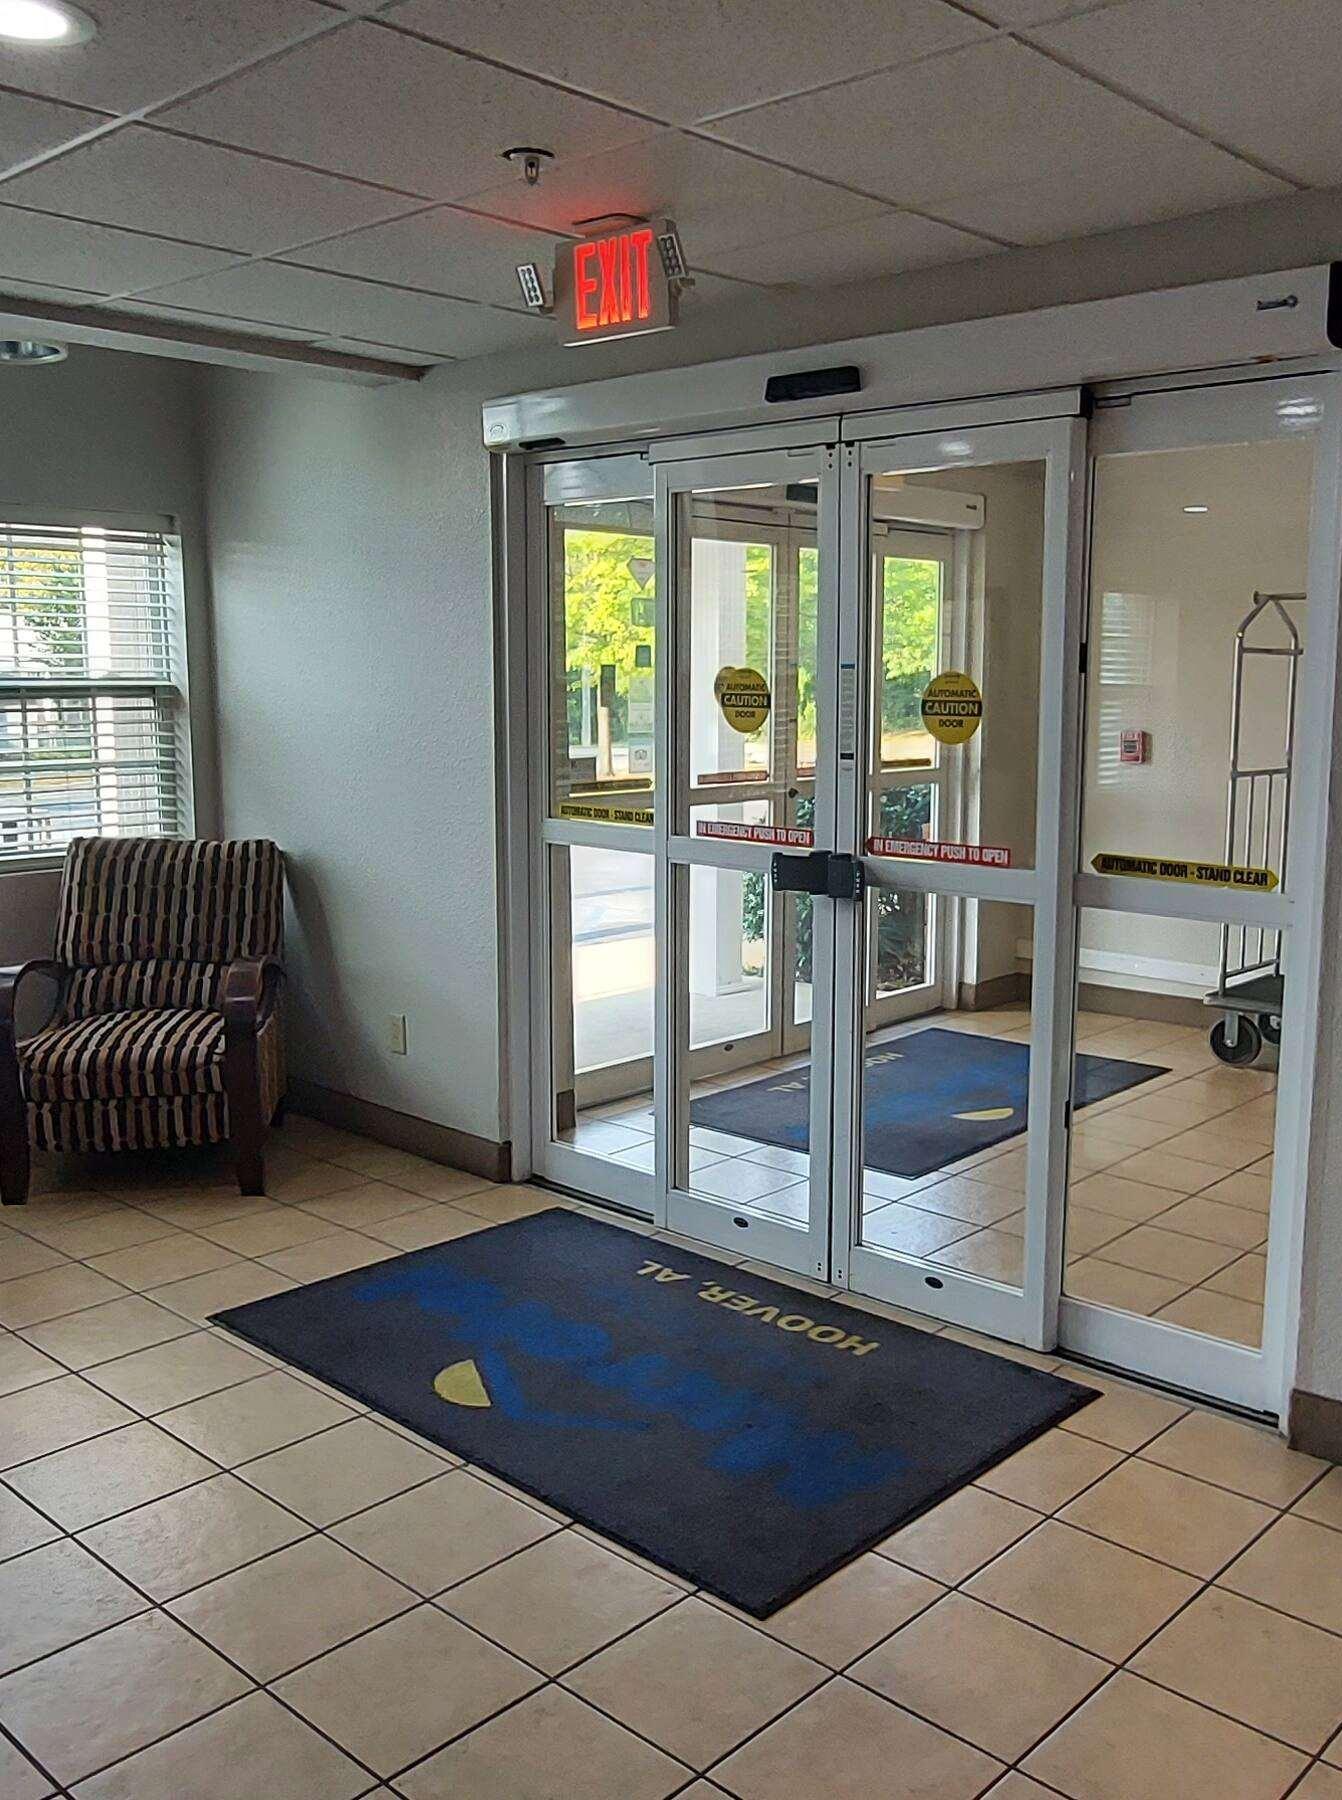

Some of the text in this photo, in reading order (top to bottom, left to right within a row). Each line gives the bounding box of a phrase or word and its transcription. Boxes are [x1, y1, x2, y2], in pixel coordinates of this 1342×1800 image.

[574, 229, 653, 329] EXIT
[724, 695, 767, 706] CAUTION
[928, 689, 976, 698] AUTOMATIC
[735, 710, 755, 718] DOOR
[925, 702, 978, 714] CAUTION
[939, 719, 964, 728] DOOR
[707, 823, 752, 839] EMERGENCY
[753, 827, 775, 840] PUSH
[776, 829, 786, 842] TO
[788, 830, 811, 844] OPEN
[873, 839, 1009, 864] IN EMERGENCY PUSH TO OPEN
[1101, 857, 1158, 875] AUTOMATIC
[1159, 862, 1188, 878] DOOR
[1195, 866, 1232, 883] STAND
[1233, 869, 1268, 886] CLEAR
[636, 1260, 881, 1356] HOOVER, AL
